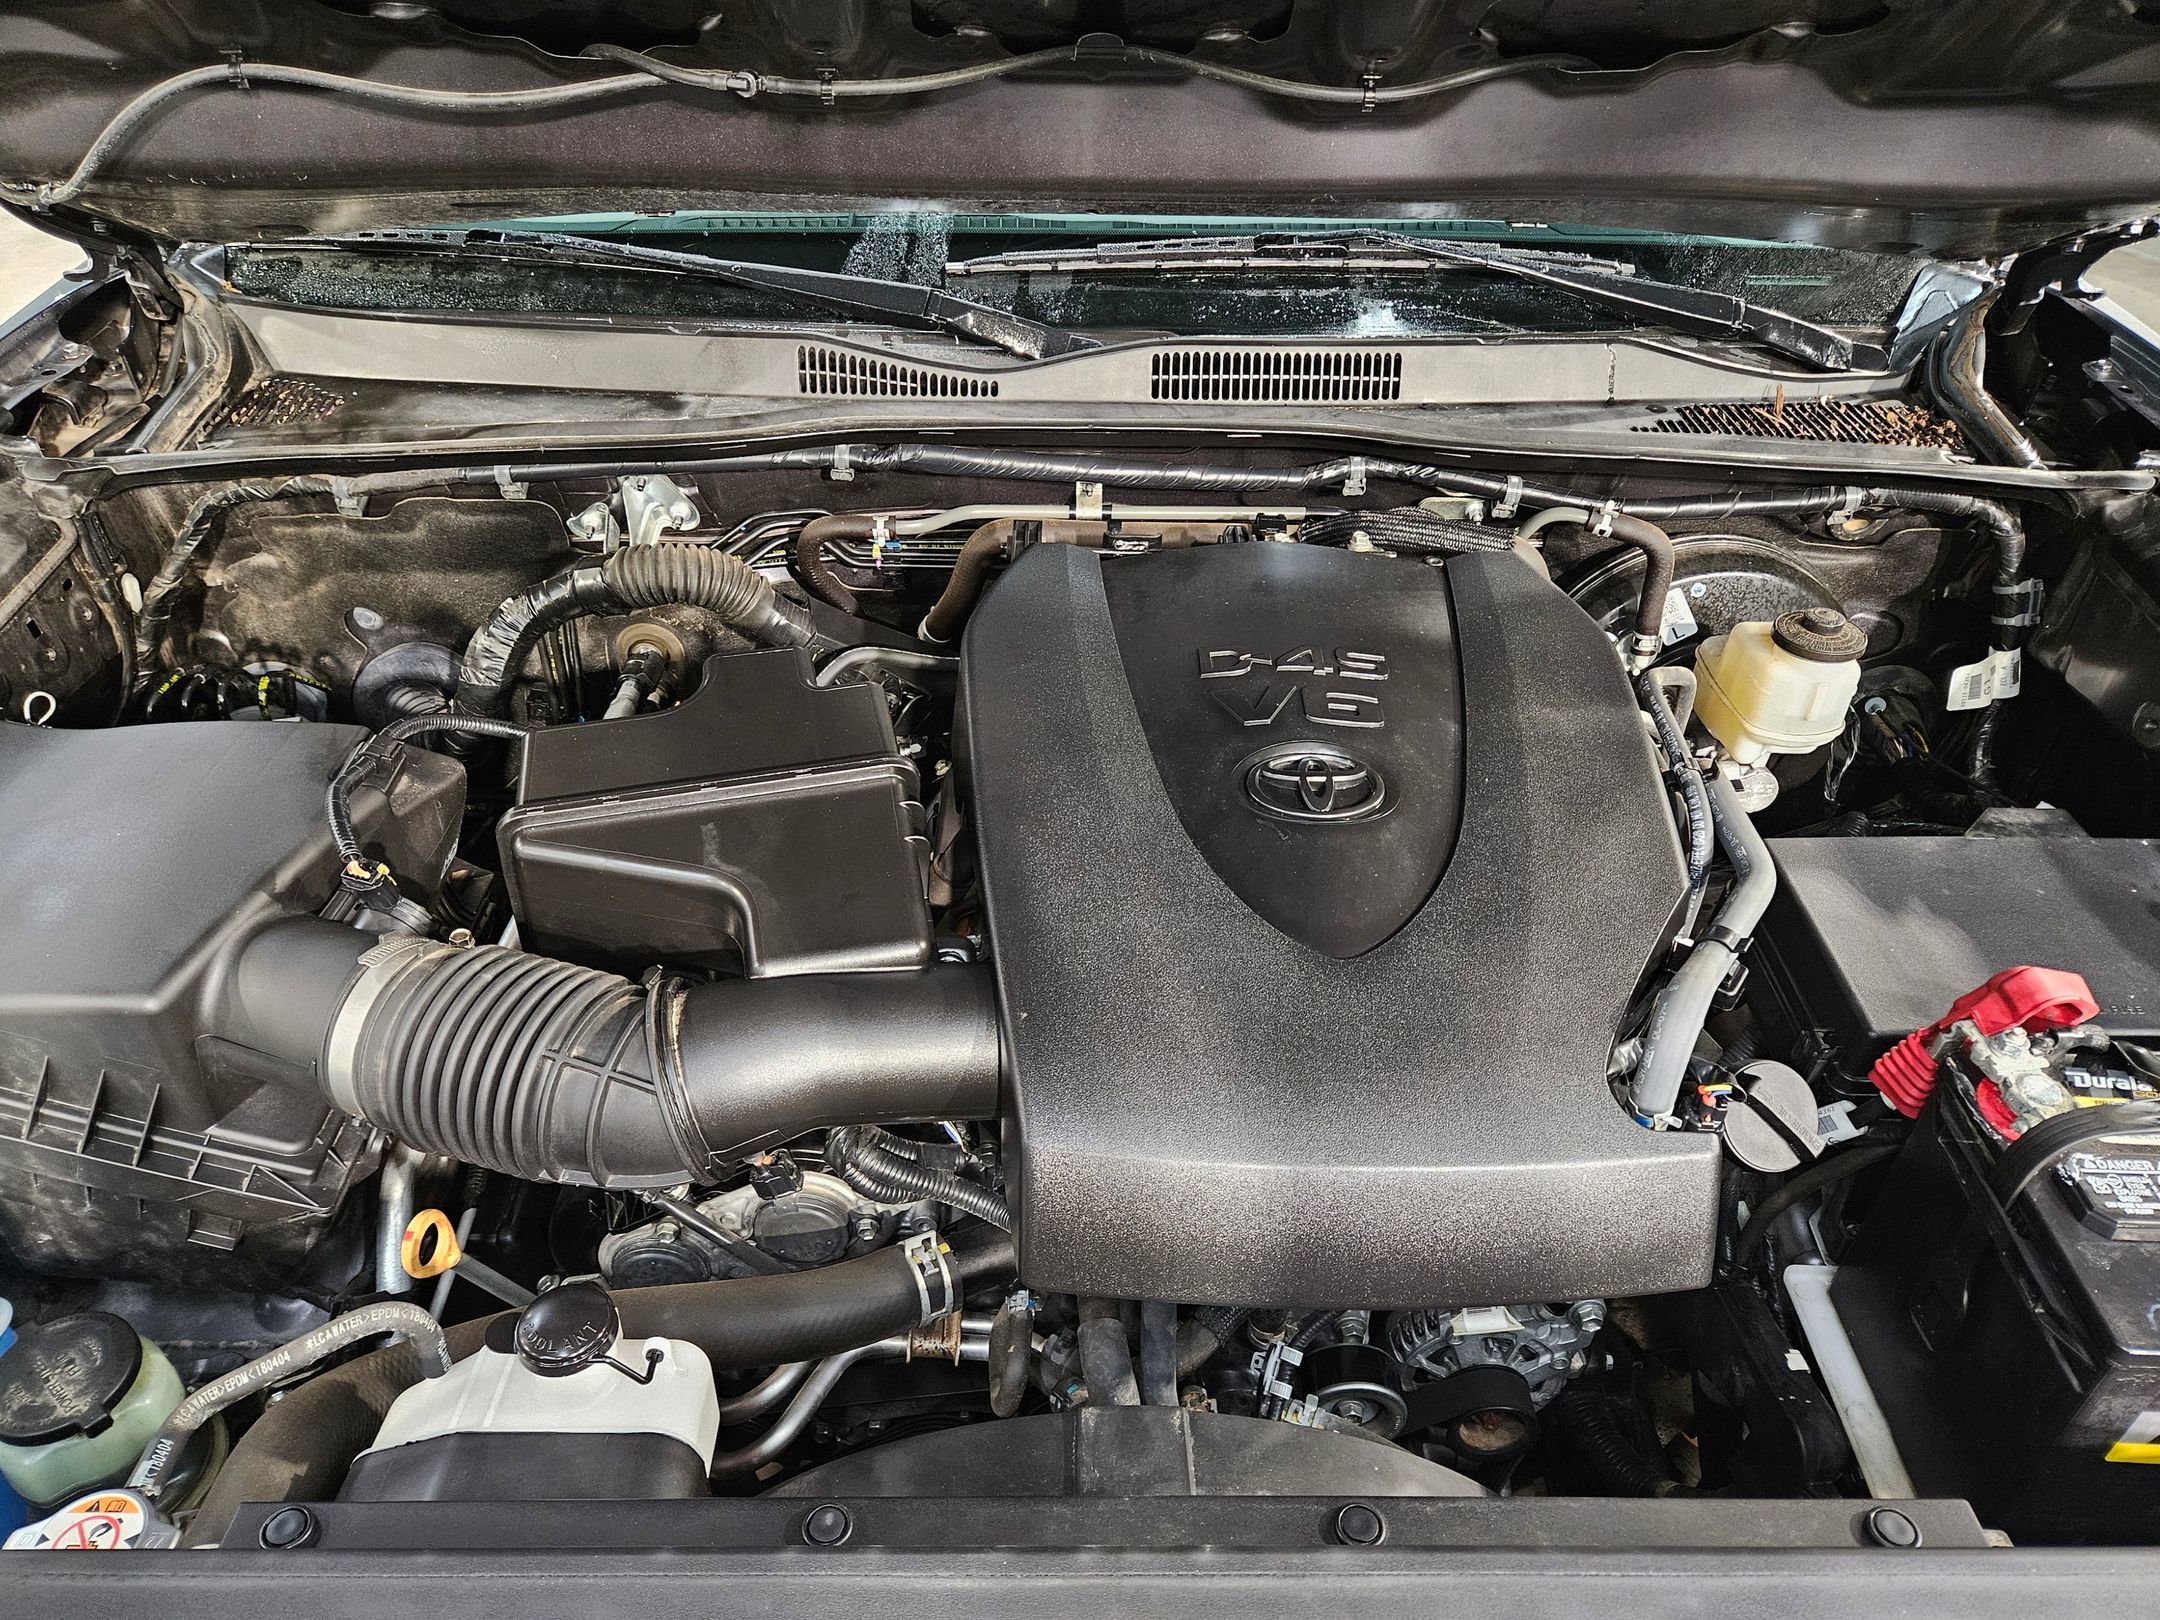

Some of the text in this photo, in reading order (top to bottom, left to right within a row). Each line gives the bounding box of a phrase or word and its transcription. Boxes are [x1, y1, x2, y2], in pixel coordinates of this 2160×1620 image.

[1197, 644, 1390, 681] D-4S
[1207, 685, 1385, 728] V6
[1777, 1106, 1821, 1151] ENGINE OIL
[2096, 1159, 2154, 1171] DANGER
[521, 1321, 598, 1354] COOLANT
